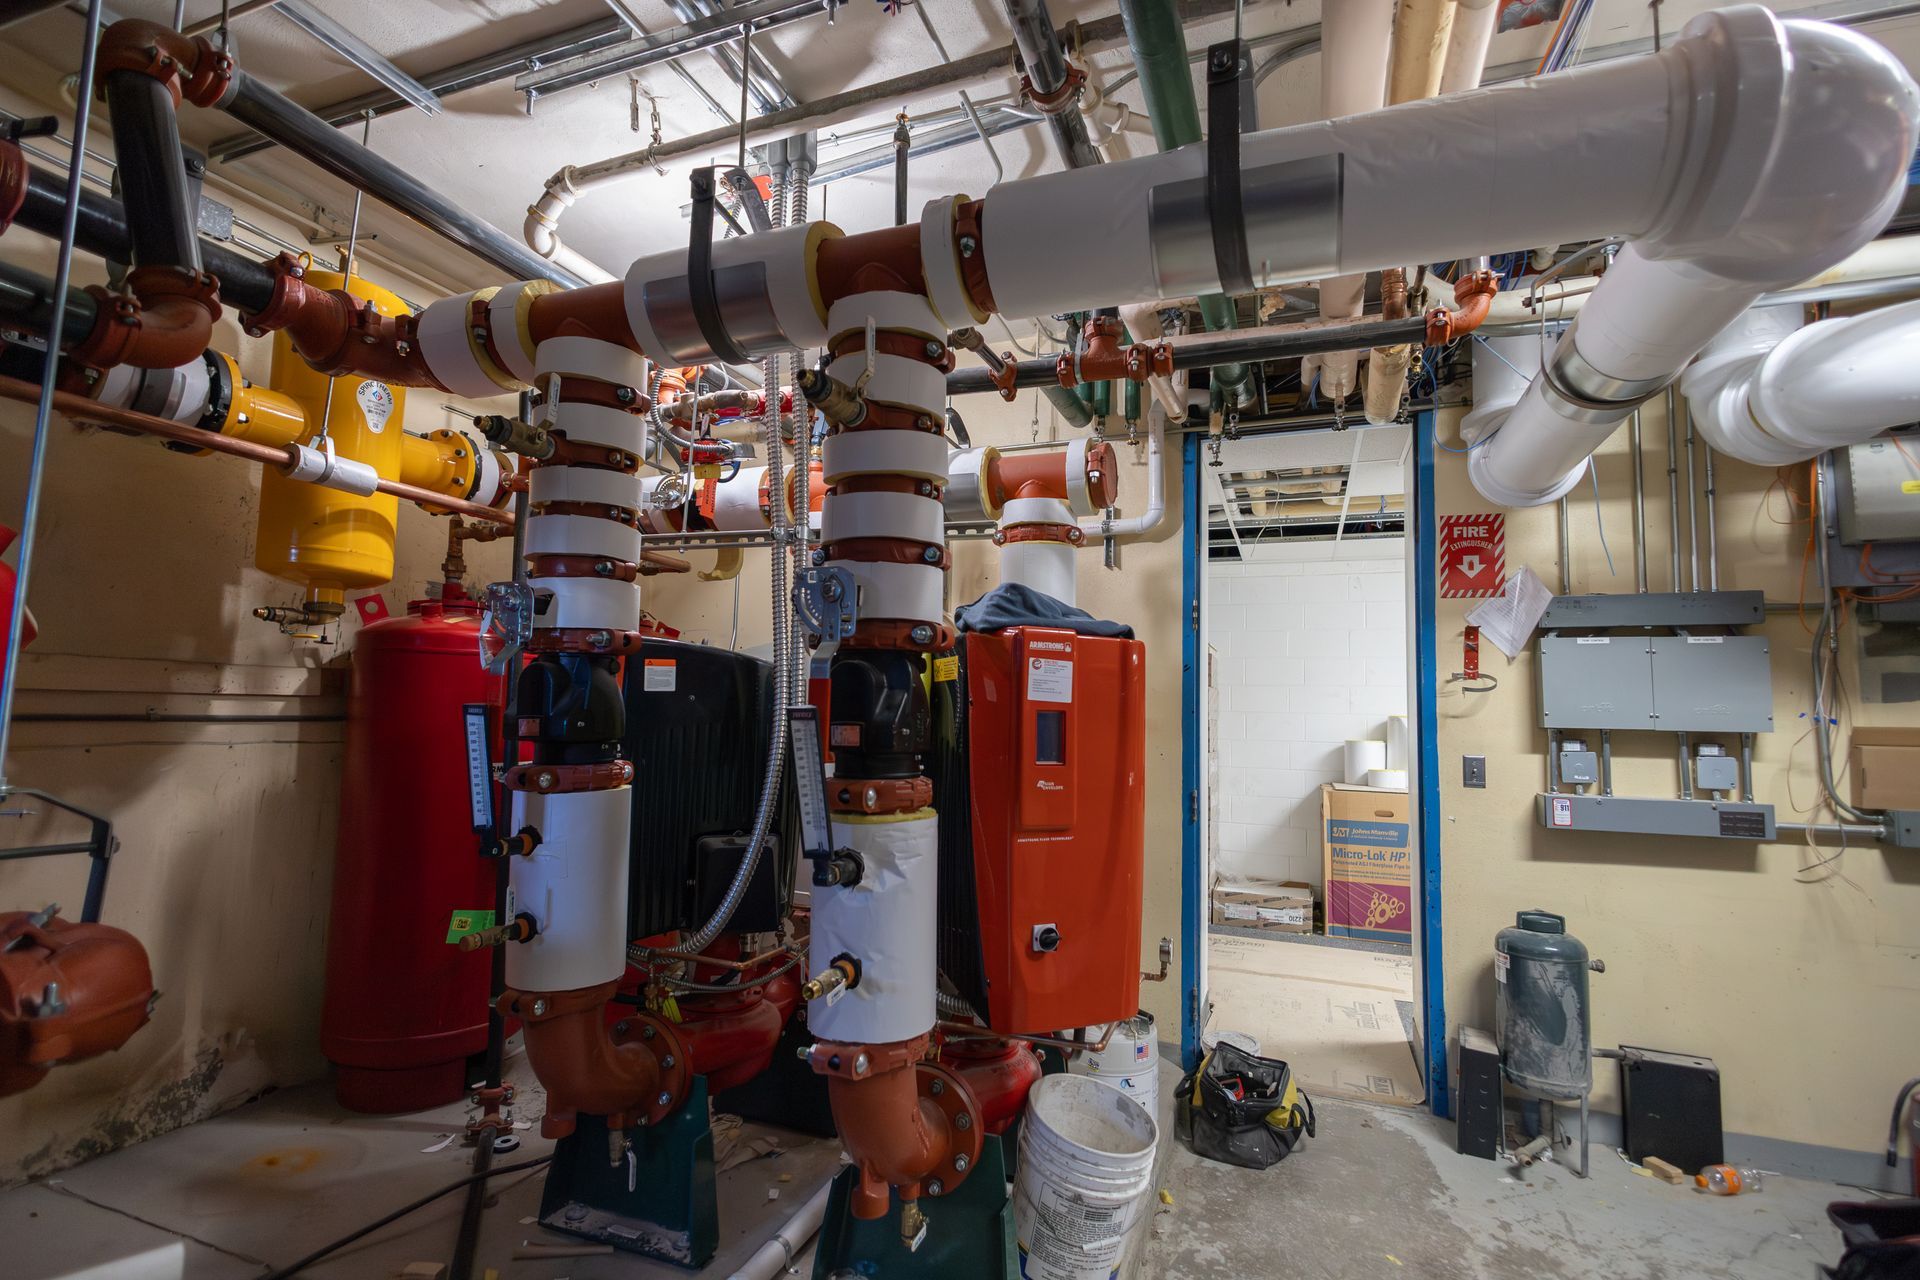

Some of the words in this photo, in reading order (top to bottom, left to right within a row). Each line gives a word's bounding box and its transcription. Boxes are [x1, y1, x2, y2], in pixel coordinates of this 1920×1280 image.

[1453, 525, 1489, 538] FIRE
[1449, 540, 1494, 551] EXTINGUISHER
[1029, 640, 1065, 650] ARMSTRONG
[1332, 847, 1386, 861] Micro-Lok
[1390, 852, 1406, 862] HP
